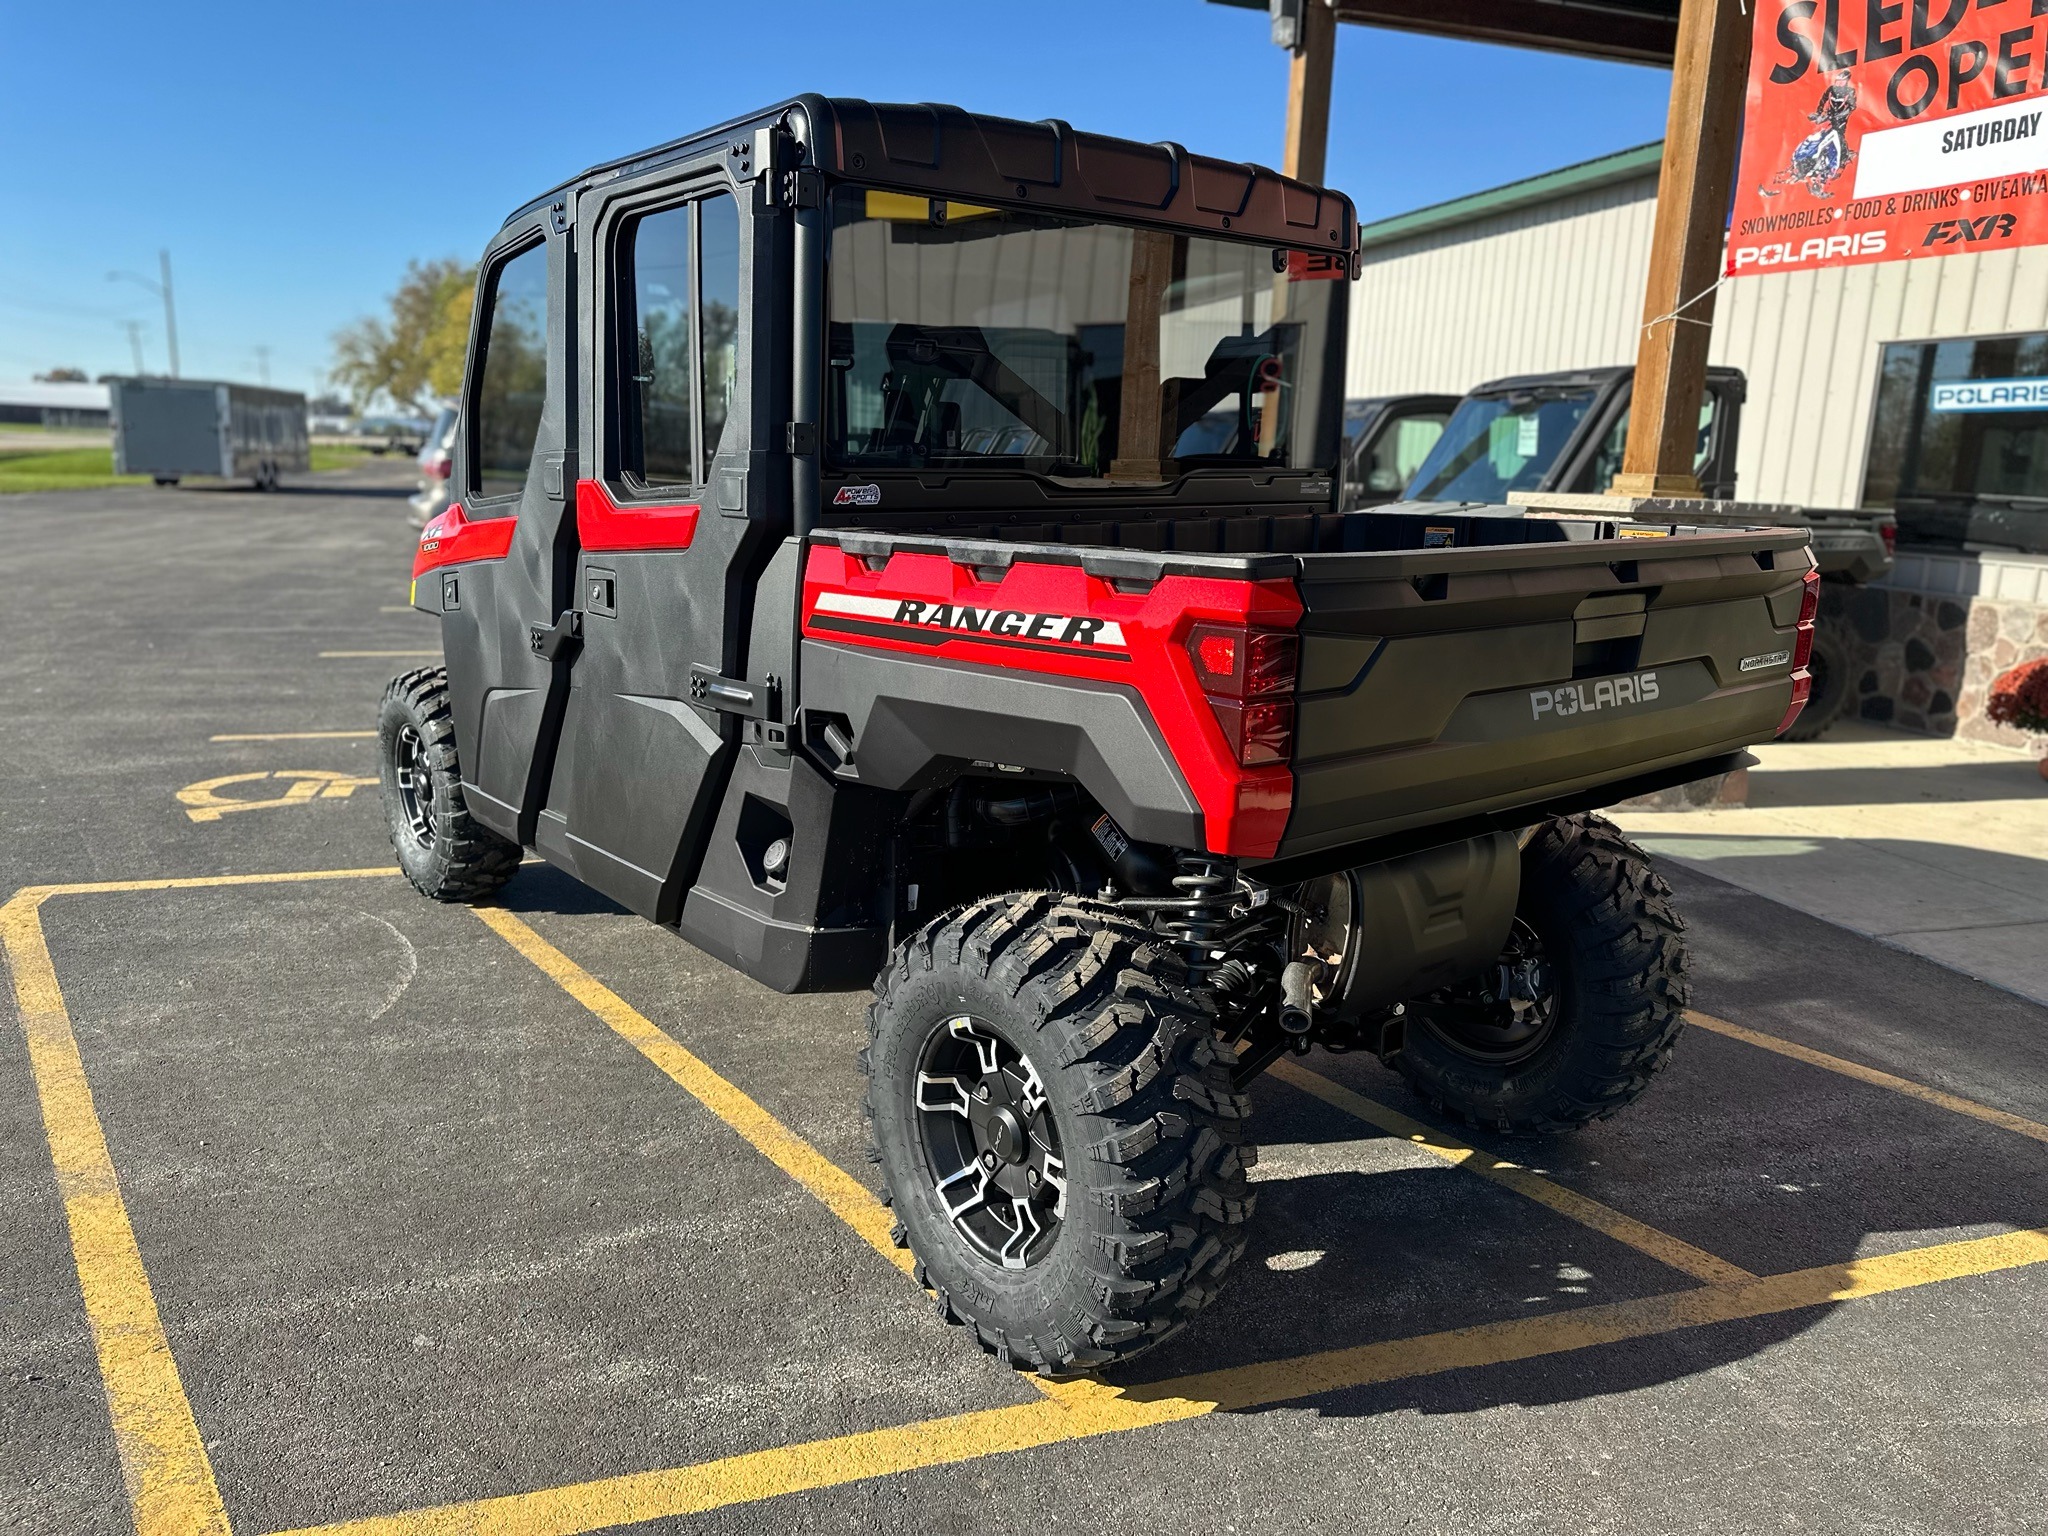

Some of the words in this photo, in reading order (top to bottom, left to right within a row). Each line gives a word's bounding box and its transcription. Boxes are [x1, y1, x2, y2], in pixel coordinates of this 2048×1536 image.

[1886, 25, 2048, 119] OPE
[1941, 111, 2042, 154] SATURDAY
[1740, 206, 1834, 236] SNOWMOBILES
[1844, 200, 1882, 221] FOOD
[1902, 188, 1959, 213] DRINKS
[1921, 212, 2017, 247] FXR
[1735, 230, 1887, 269] POLARIS
[892, 599, 1106, 646] RANGER
[1743, 652, 1788, 670] NORTHSTAR
[1529, 672, 1660, 721] POLARIS
